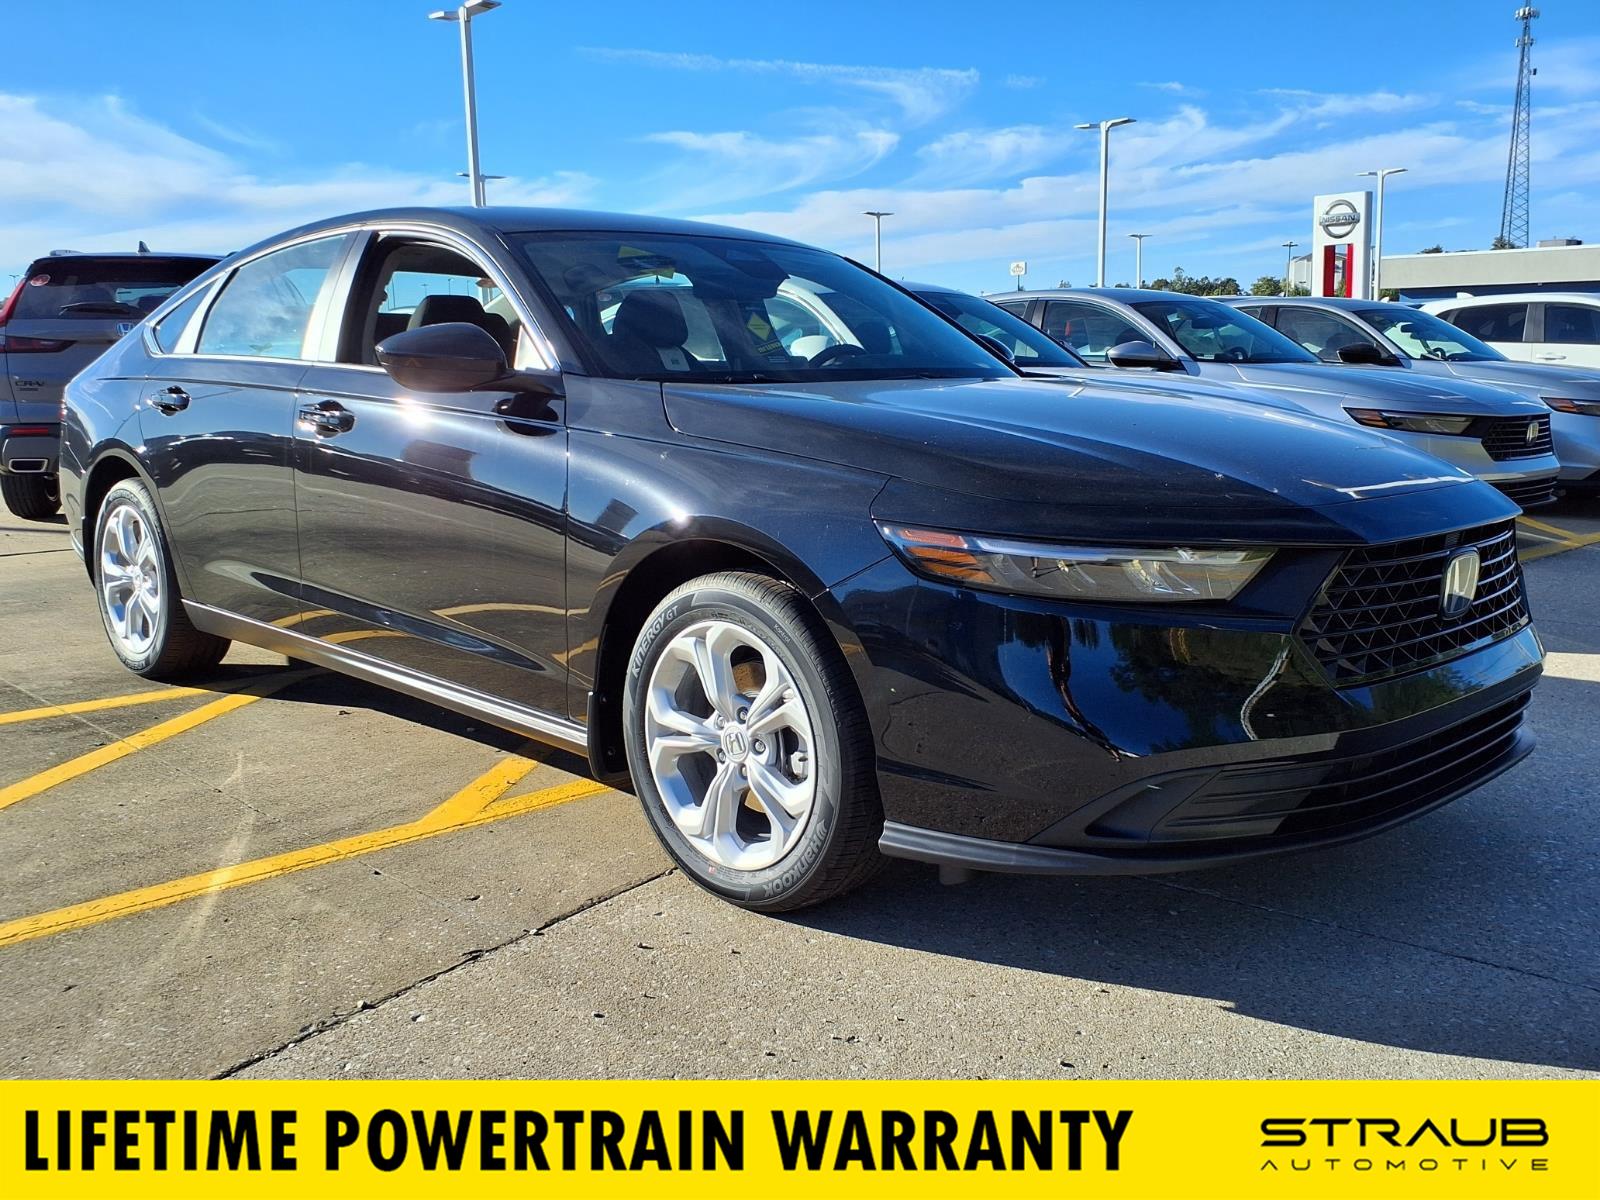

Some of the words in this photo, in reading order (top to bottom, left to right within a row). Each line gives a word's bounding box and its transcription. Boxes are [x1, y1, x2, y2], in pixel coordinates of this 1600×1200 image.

[1321, 214, 1356, 223] NISSAN
[631, 612, 665, 679] KINERGY
[666, 605, 679, 621] GT
